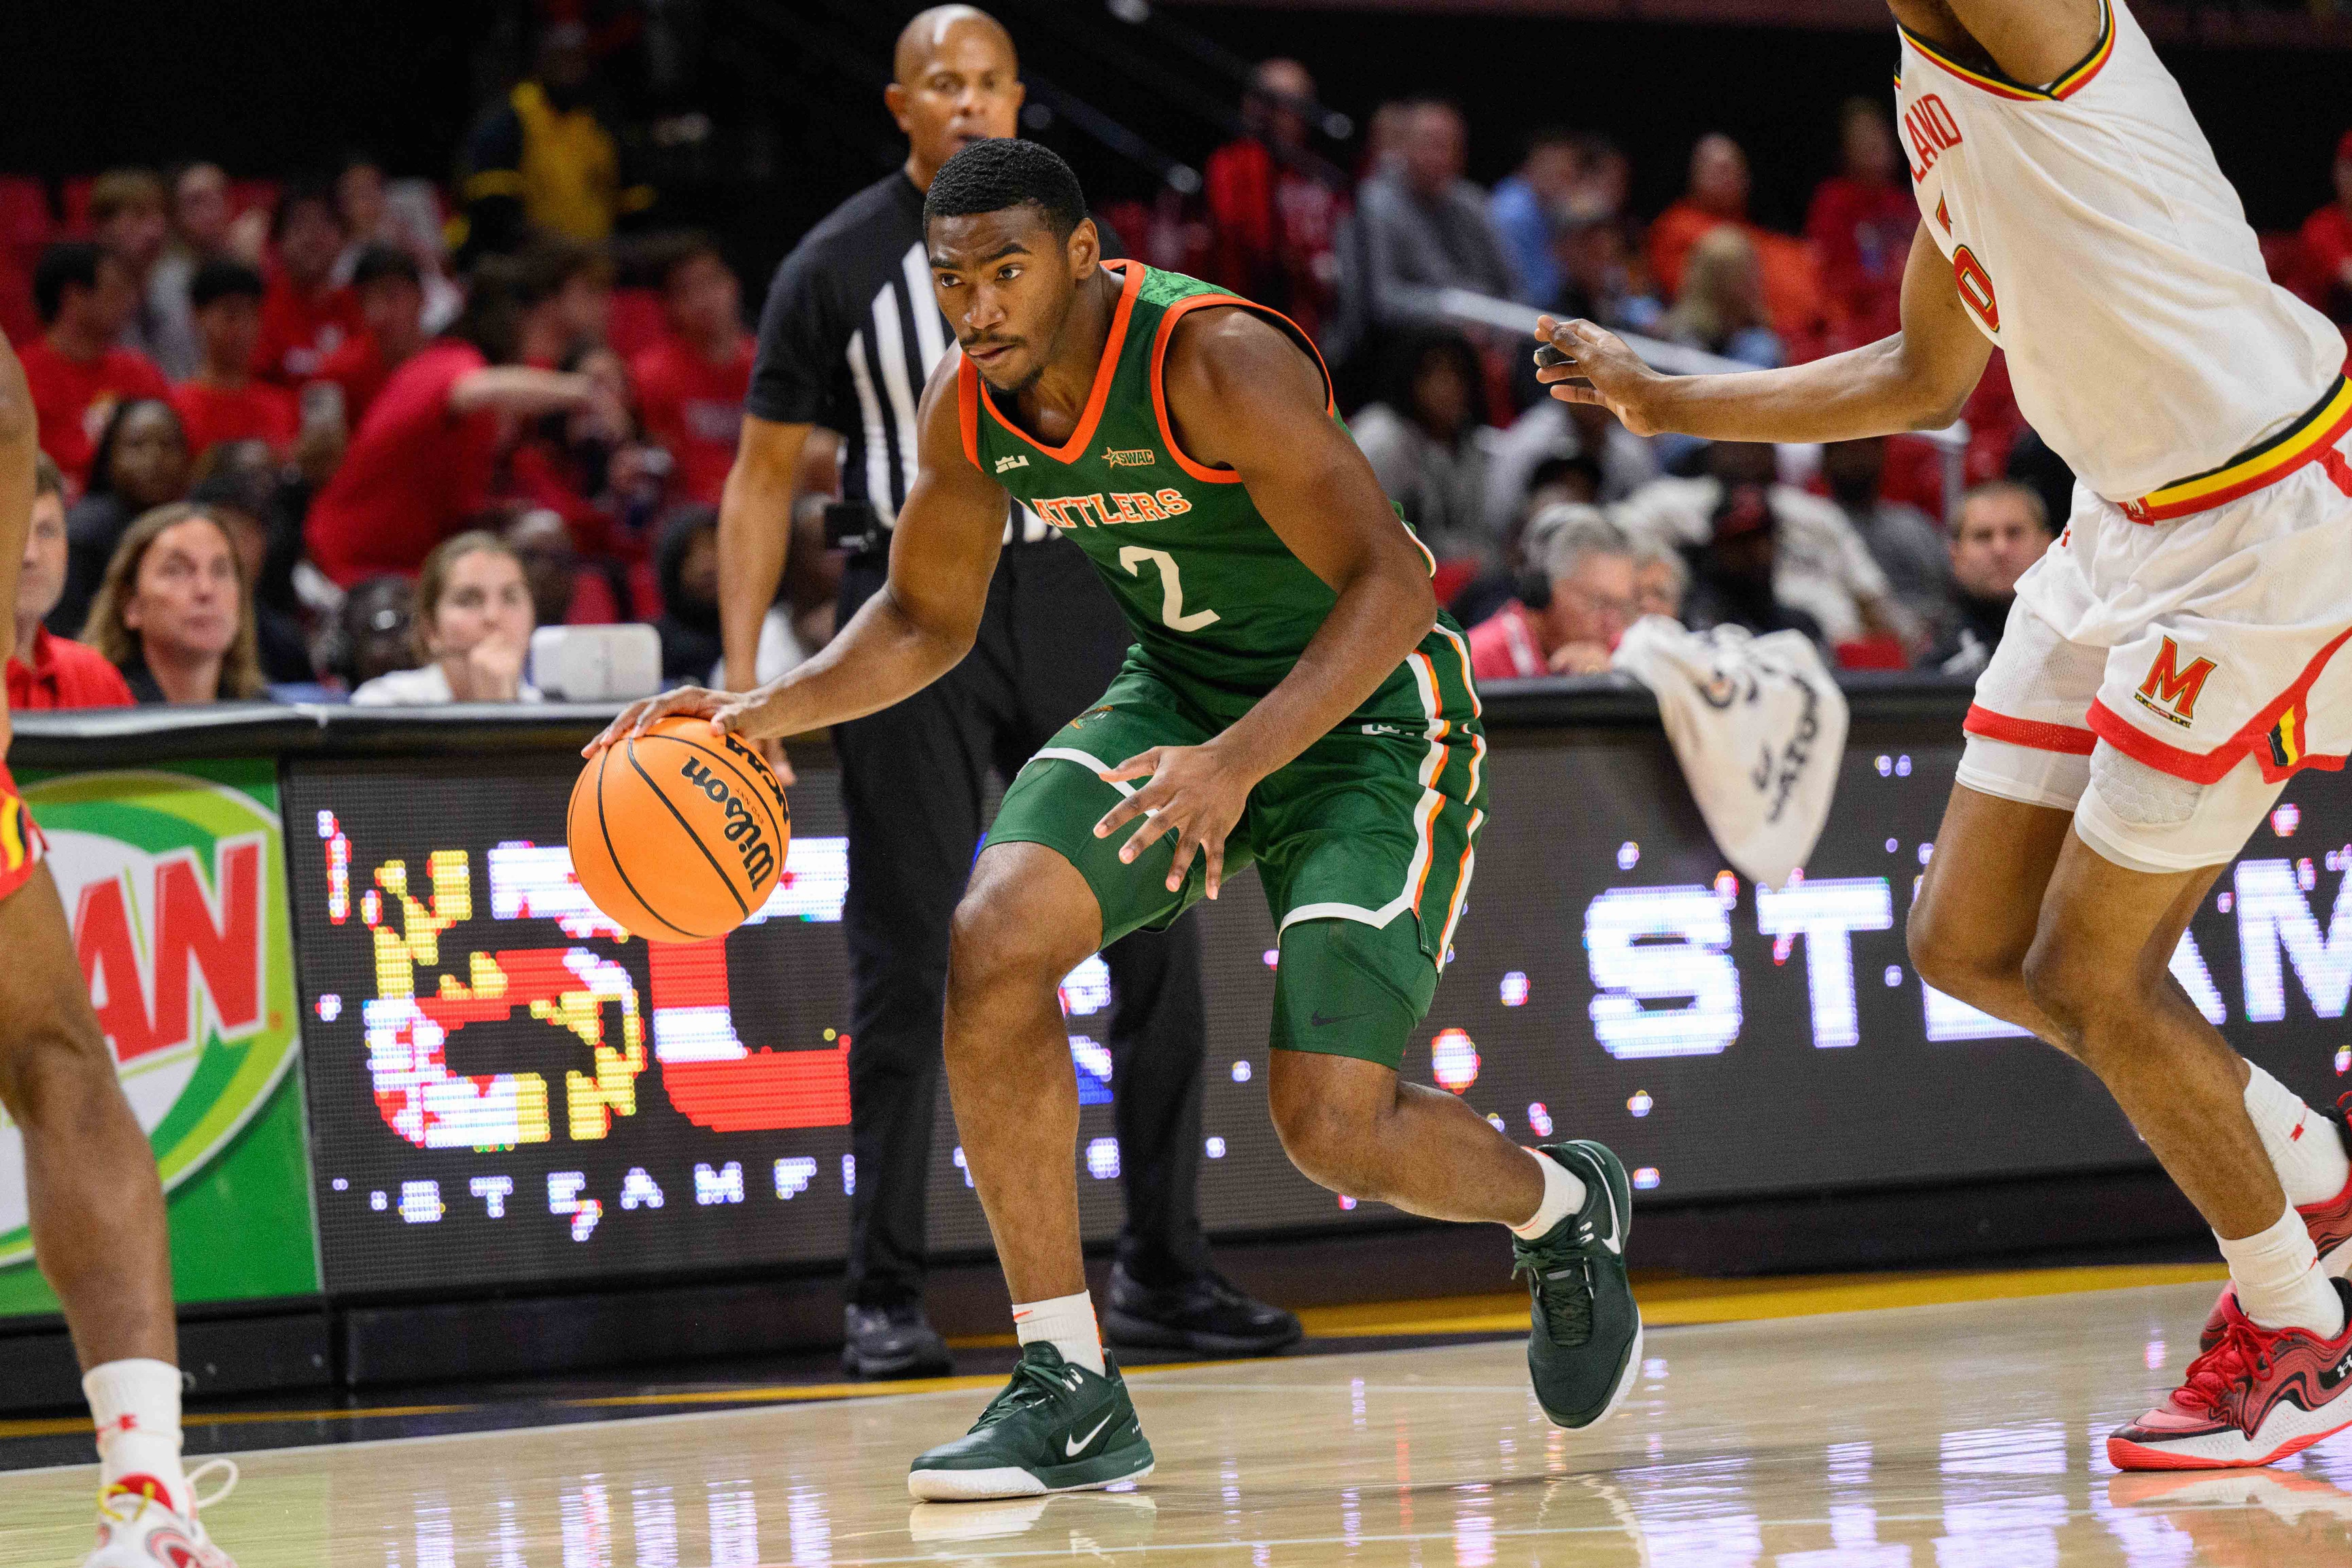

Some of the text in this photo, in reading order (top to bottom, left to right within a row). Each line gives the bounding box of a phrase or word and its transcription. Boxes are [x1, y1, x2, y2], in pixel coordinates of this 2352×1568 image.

[1117, 450, 1154, 465] SWAC
[1021, 487, 1192, 529] ATTLERS
[1119, 545, 1221, 632] 2
[2139, 633, 2217, 720] M
[725, 735, 789, 824] NCAA
[680, 755, 776, 893] Wilson
